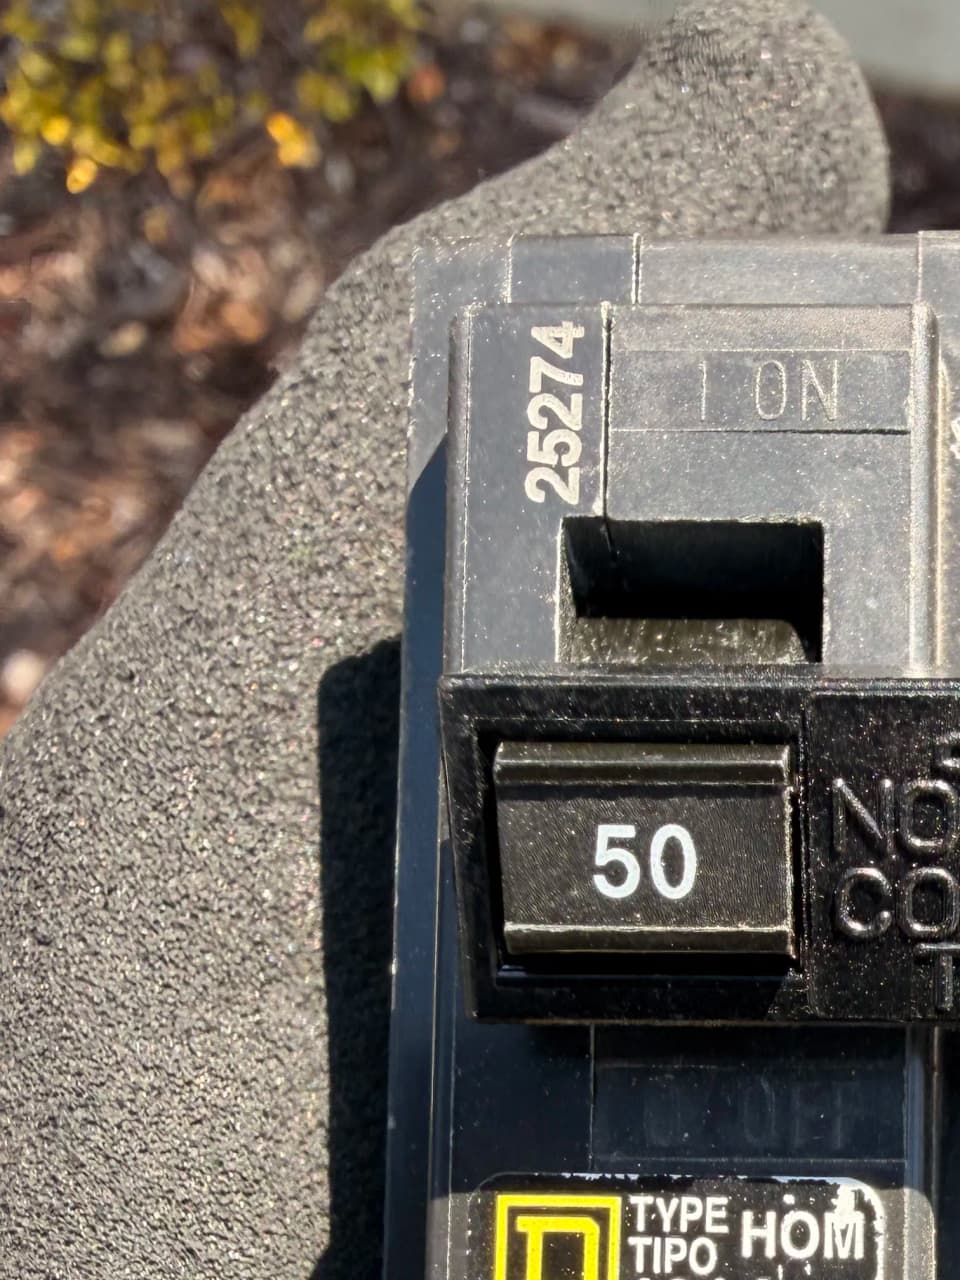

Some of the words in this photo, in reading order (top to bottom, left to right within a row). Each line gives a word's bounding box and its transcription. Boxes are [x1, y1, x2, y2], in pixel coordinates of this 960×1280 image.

[525, 320, 586, 504] 25274
[592, 823, 698, 900] 50
[627, 1235, 718, 1275] TIPO
[628, 1195, 730, 1234] TYPE
[741, 1210, 866, 1260] HOM
